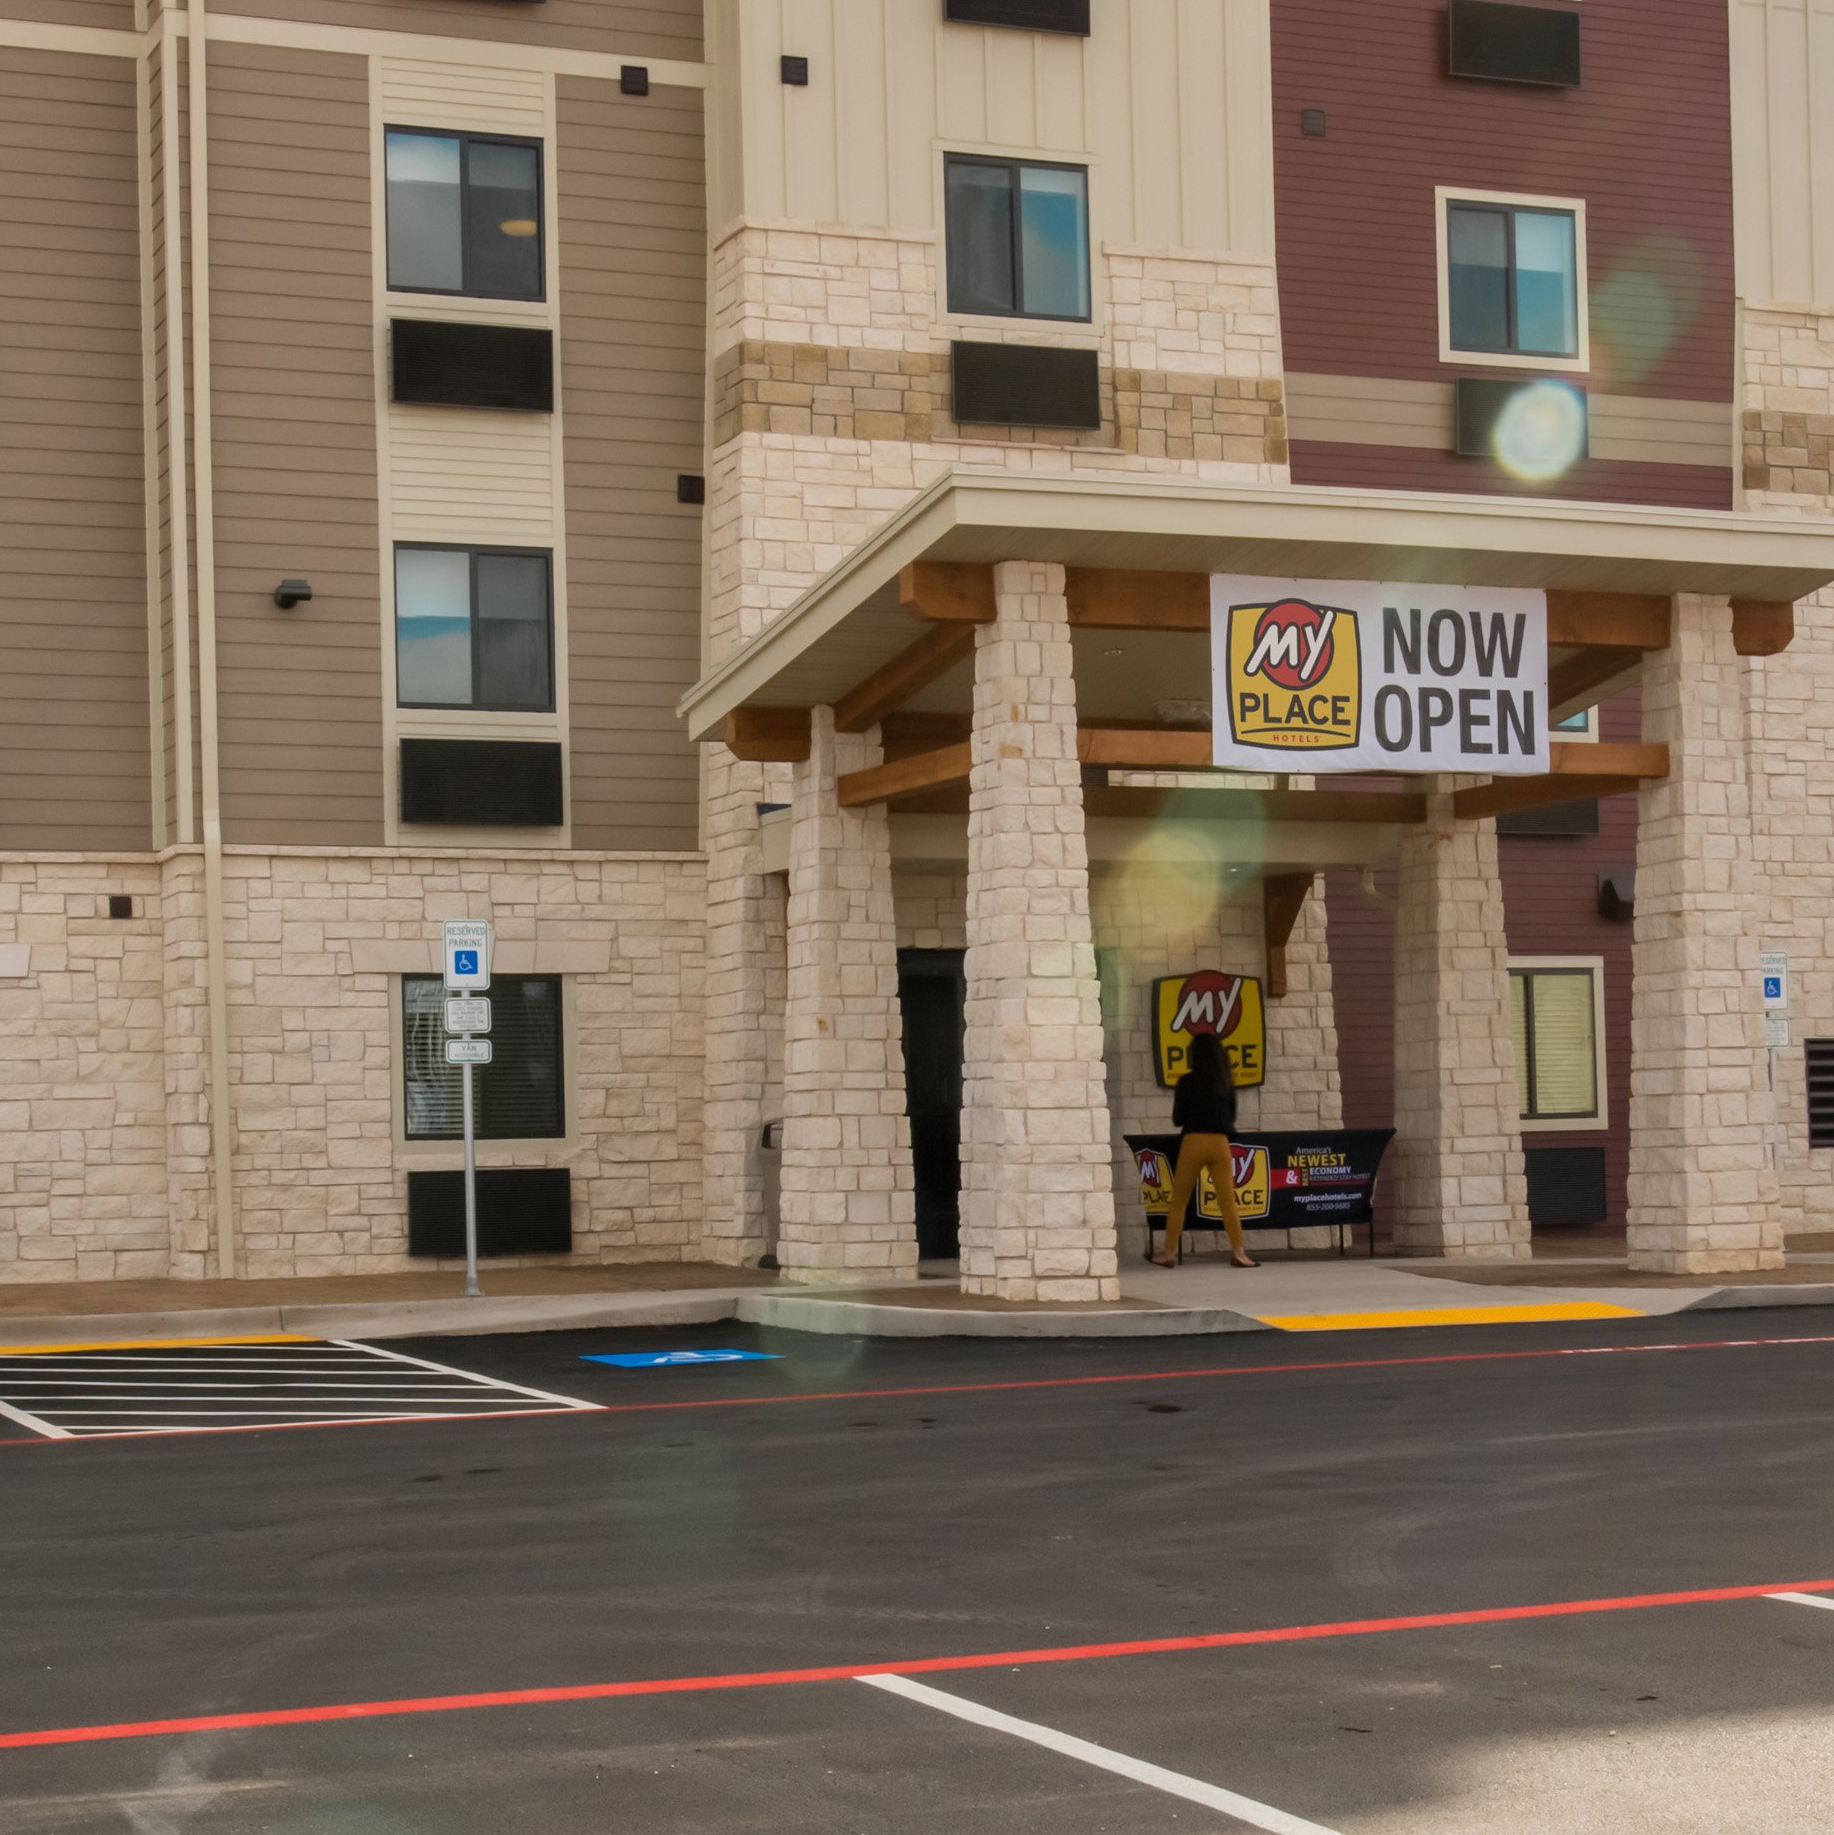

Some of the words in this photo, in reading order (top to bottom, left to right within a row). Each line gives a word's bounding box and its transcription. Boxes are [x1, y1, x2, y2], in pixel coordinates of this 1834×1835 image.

[1383, 607, 1526, 678] NOW
[1240, 692, 1351, 725] PLACE
[1374, 684, 1536, 755] OPEN
[1273, 734, 1320, 743] HOTELS
[447, 927, 486, 935] RESERVED
[449, 938, 482, 947] PARKING
[1287, 1154, 1346, 1167] NEWEST
[1286, 1170, 1298, 1184] &
[1309, 1166, 1352, 1175] ECONOMY
